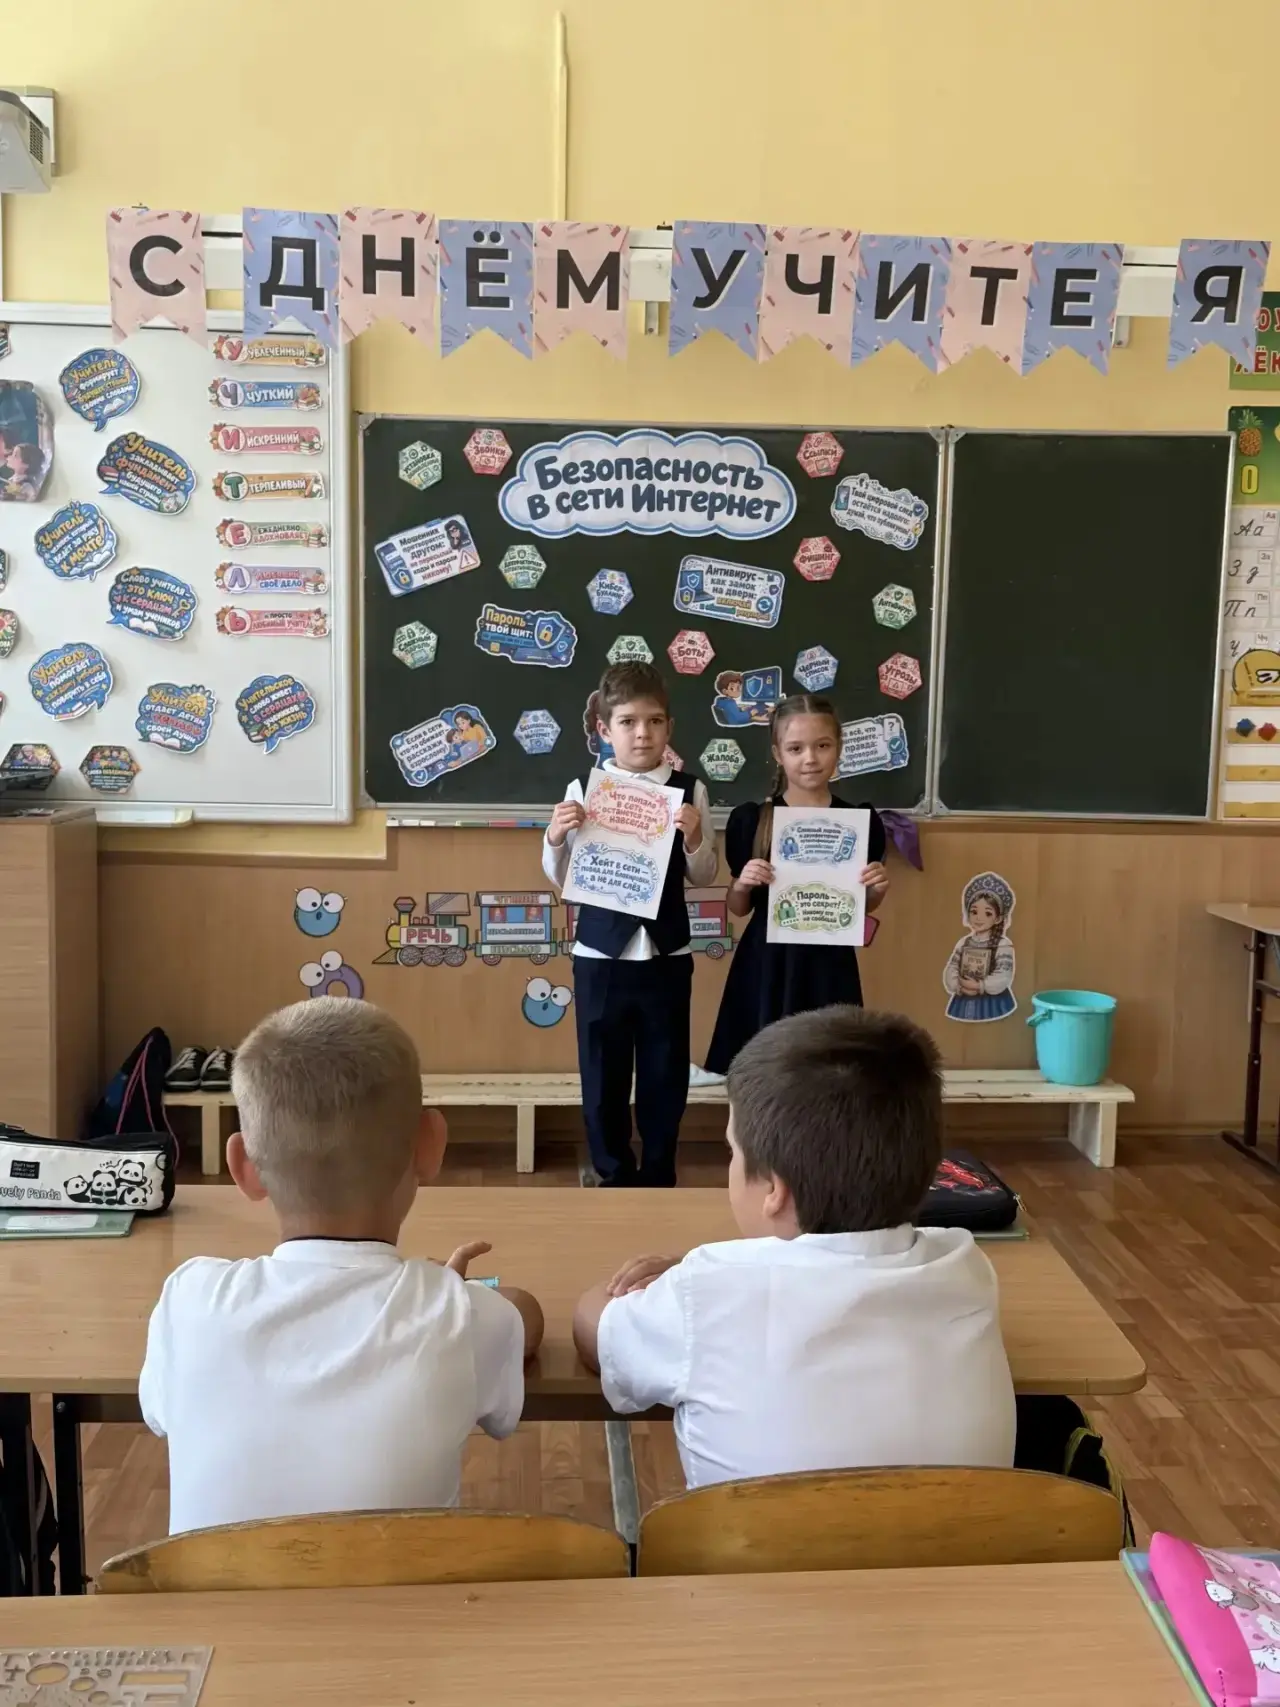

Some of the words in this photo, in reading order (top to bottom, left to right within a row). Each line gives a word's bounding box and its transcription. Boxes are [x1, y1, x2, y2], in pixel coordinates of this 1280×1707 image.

[129, 235, 186, 297] С
[259, 230, 622, 312] ДНЁМ
[70, 360, 117, 384] Учитель
[220, 383, 238, 406] Ч
[247, 386, 293, 402] ЧУТКИЙ
[222, 429, 240, 450] И
[247, 432, 299, 447] ИСКРЕННИЙ
[124, 433, 187, 480] Учитель
[473, 446, 506, 457] Звонки
[126, 471, 162, 494] будущего
[534, 455, 765, 490] Безопасность
[224, 476, 243, 498] Т
[249, 479, 306, 494] ТЕРПЕЛИВЫЙ
[527, 493, 550, 521] в
[555, 487, 624, 514] сети
[631, 483, 782, 523] Интернет
[851, 487, 866, 499] Твой
[866, 494, 898, 510] цифровой
[40, 516, 84, 548] Учитель
[229, 524, 247, 545] Е
[399, 527, 440, 547] Мошенник
[411, 541, 446, 560] другом:
[413, 565, 430, 575] коды
[435, 555, 458, 567] пароли
[705, 565, 757, 582] Антивирус
[121, 572, 149, 583] Слово
[151, 578, 185, 596] учителя
[280, 579, 302, 588] ДЕЛО
[710, 577, 726, 585] как
[728, 579, 756, 592] замок
[712, 586, 724, 594] на
[126, 584, 145, 595] это
[147, 589, 174, 604] ключ
[130, 596, 172, 615] сердцам
[122, 605, 144, 618] умам
[144, 611, 180, 629] учеников
[485, 609, 526, 629] Пароль
[485, 622, 509, 634] твой
[511, 628, 534, 640] щит:
[615, 651, 646, 661] Защита
[677, 646, 706, 657] Боты
[33, 651, 85, 685] Учитель
[49, 659, 91, 688] помогает
[90, 671, 107, 684] себя
[885, 664, 918, 684] Угрозы
[151, 688, 205, 717] Учитель
[238, 678, 294, 711] Учительское
[249, 697, 270, 714] слово
[260, 694, 298, 718] сердцах
[263, 704, 300, 727] учеников
[178, 711, 206, 726] детям
[173, 730, 196, 744] души
[400, 743, 419, 756] кто-то
[419, 730, 445, 747] обижает
[406, 734, 423, 745] Если
[427, 723, 443, 733] сети
[406, 740, 443, 763] расскажи
[707, 754, 739, 763] Жалоба
[609, 791, 626, 801] Что
[628, 795, 657, 809] попало
[624, 803, 643, 812] сеть
[601, 807, 642, 820] останется
[643, 815, 658, 824] там
[609, 815, 650, 831] навсегда
[590, 855, 614, 868] Хейт
[623, 863, 641, 875] сети
[608, 878, 622, 888] для
[623, 880, 641, 892] слёз
[797, 892, 830, 901] Пароль
[813, 901, 841, 910] секрет!
[406, 928, 452, 943] РЕЧЬ
[27, 1187, 61, 1200] Panda
